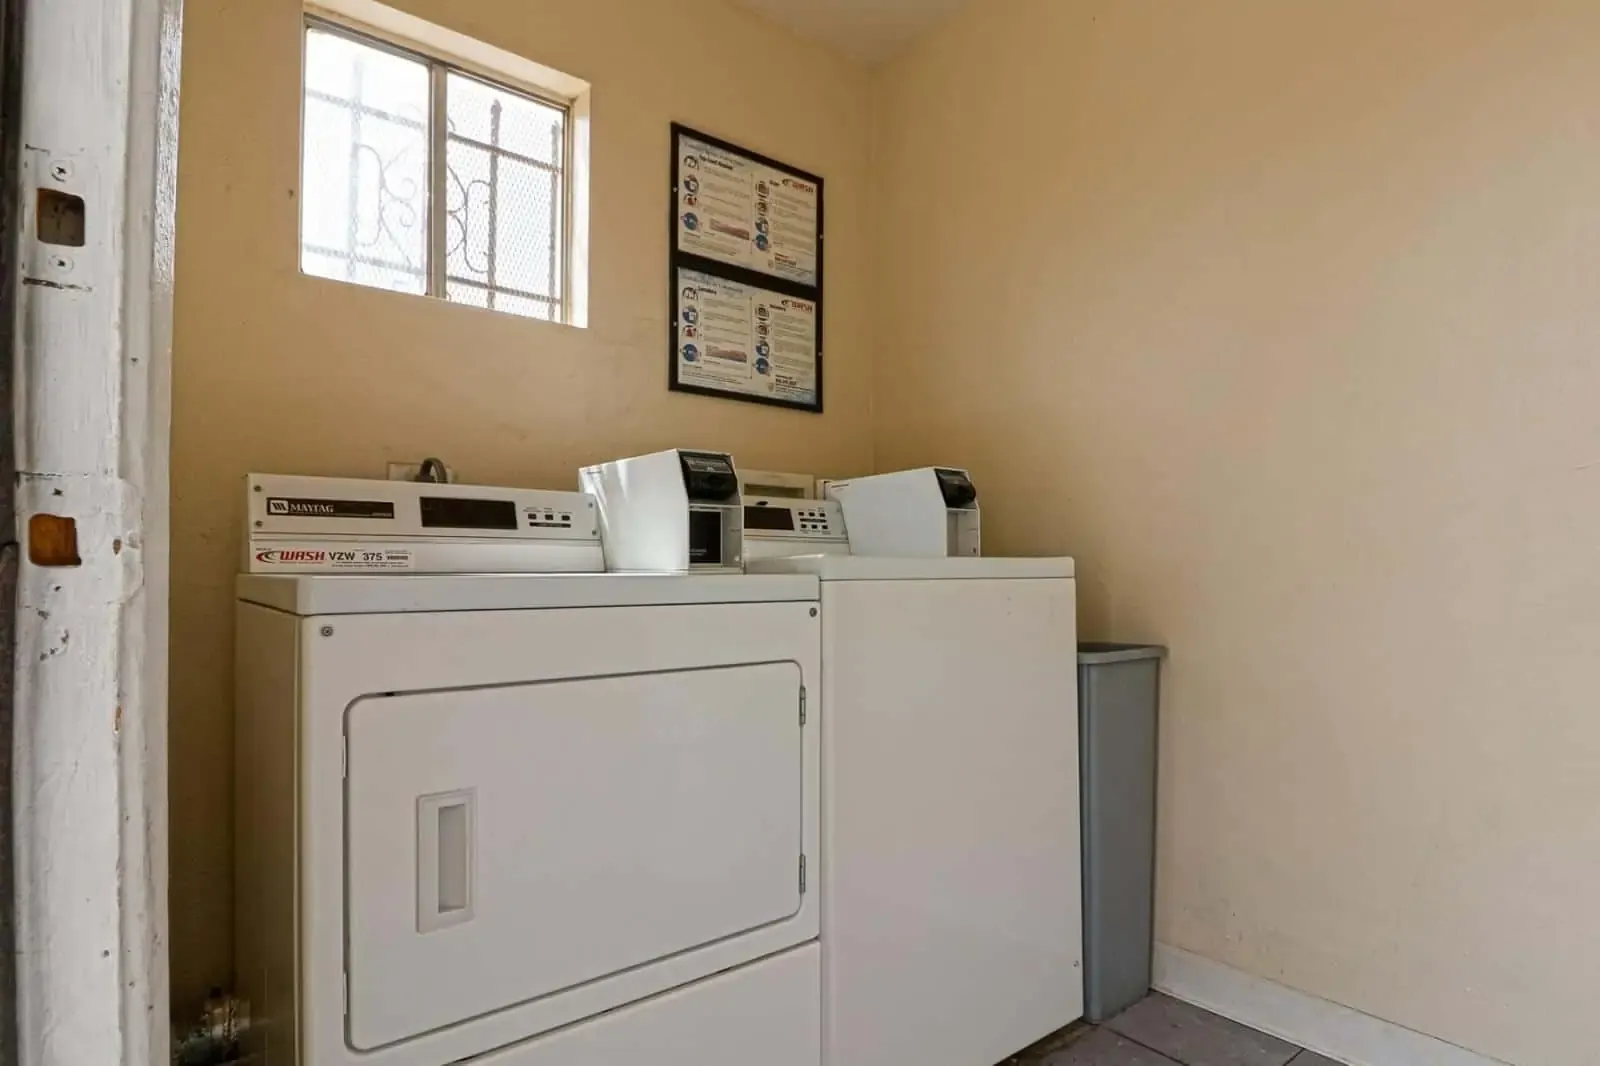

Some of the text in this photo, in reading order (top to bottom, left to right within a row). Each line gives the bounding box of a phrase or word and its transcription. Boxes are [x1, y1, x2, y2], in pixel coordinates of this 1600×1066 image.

[290, 503, 334, 513] MAYTAG
[280, 551, 326, 561] WASH
[329, 551, 356, 561] VZW
[362, 552, 383, 561] 375
